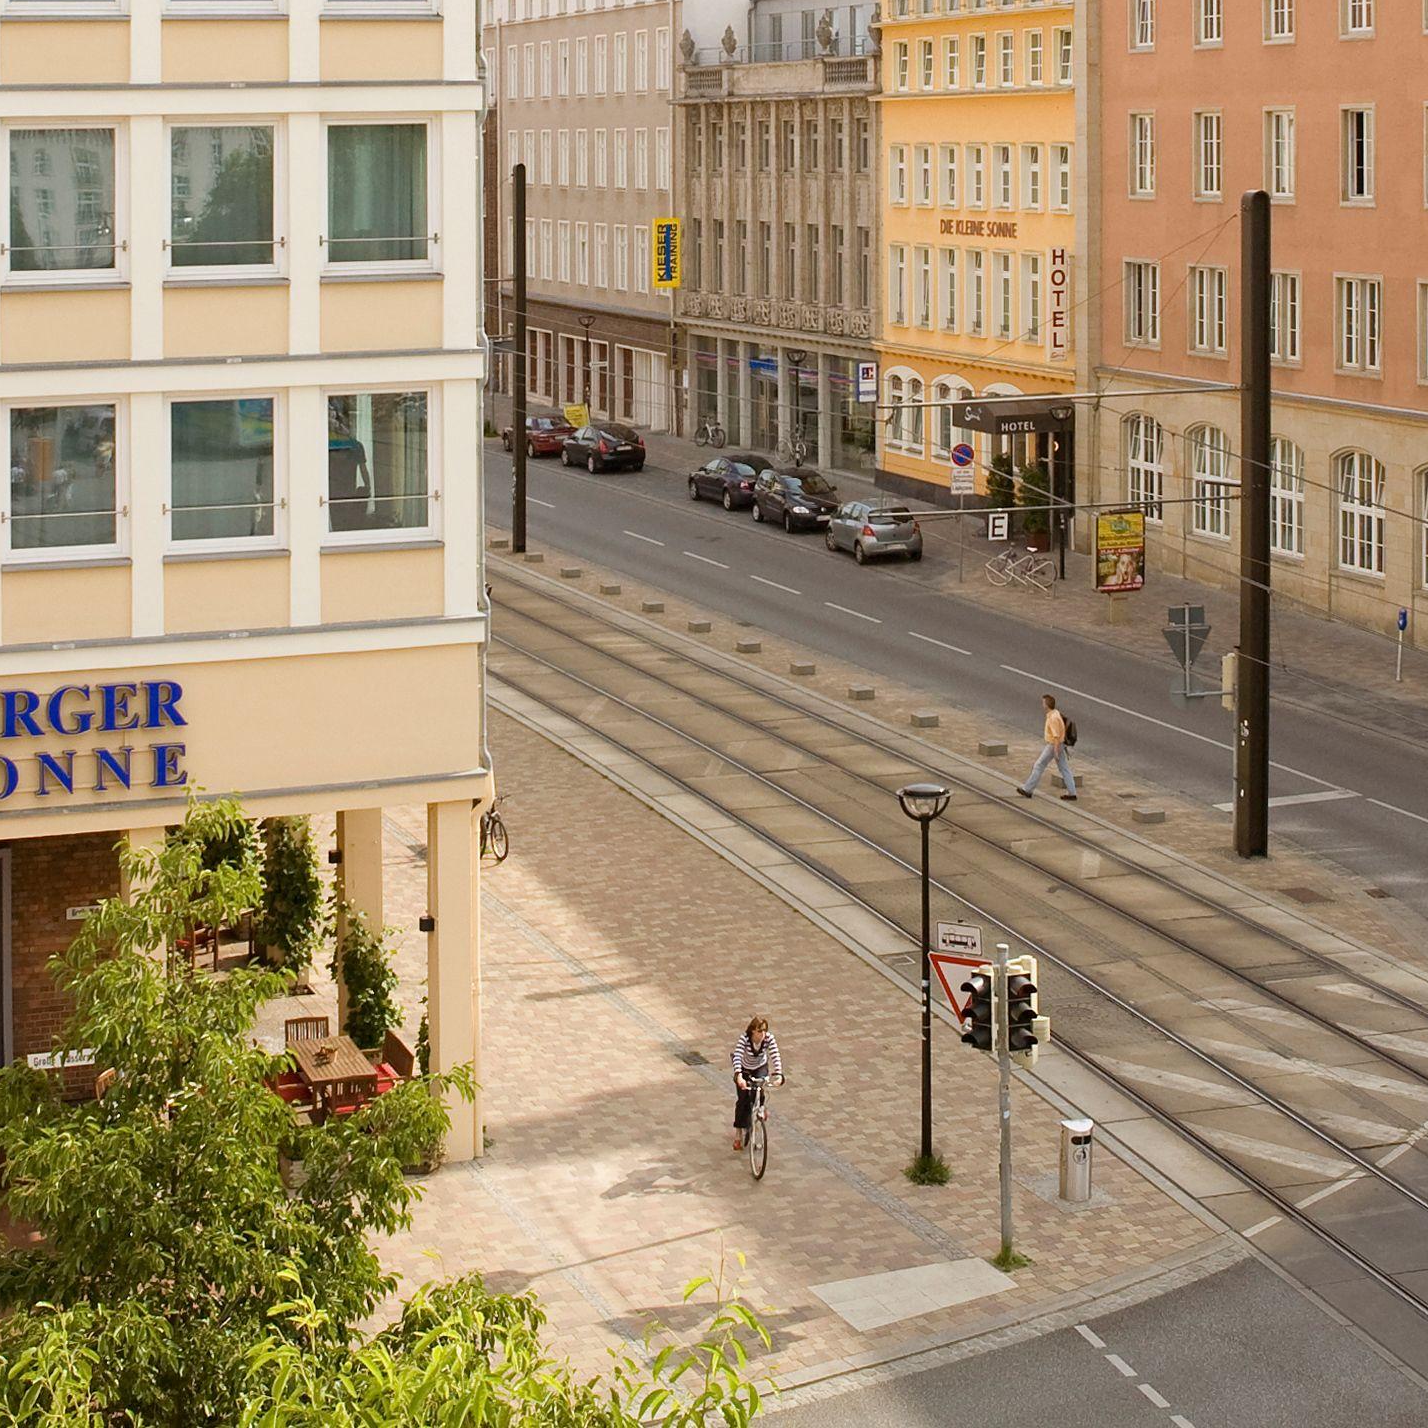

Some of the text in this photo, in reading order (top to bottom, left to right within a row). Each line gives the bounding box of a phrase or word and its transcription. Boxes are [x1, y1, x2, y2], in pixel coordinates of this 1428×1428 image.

[940, 219, 1018, 239] DIE KLEINE SONNE
[657, 223, 667, 282] KIESER
[669, 223, 678, 281] TRAINING
[1051, 249, 1065, 348] HOTEL
[1001, 421, 1035, 432] HOTEL
[991, 516, 1005, 538] E
